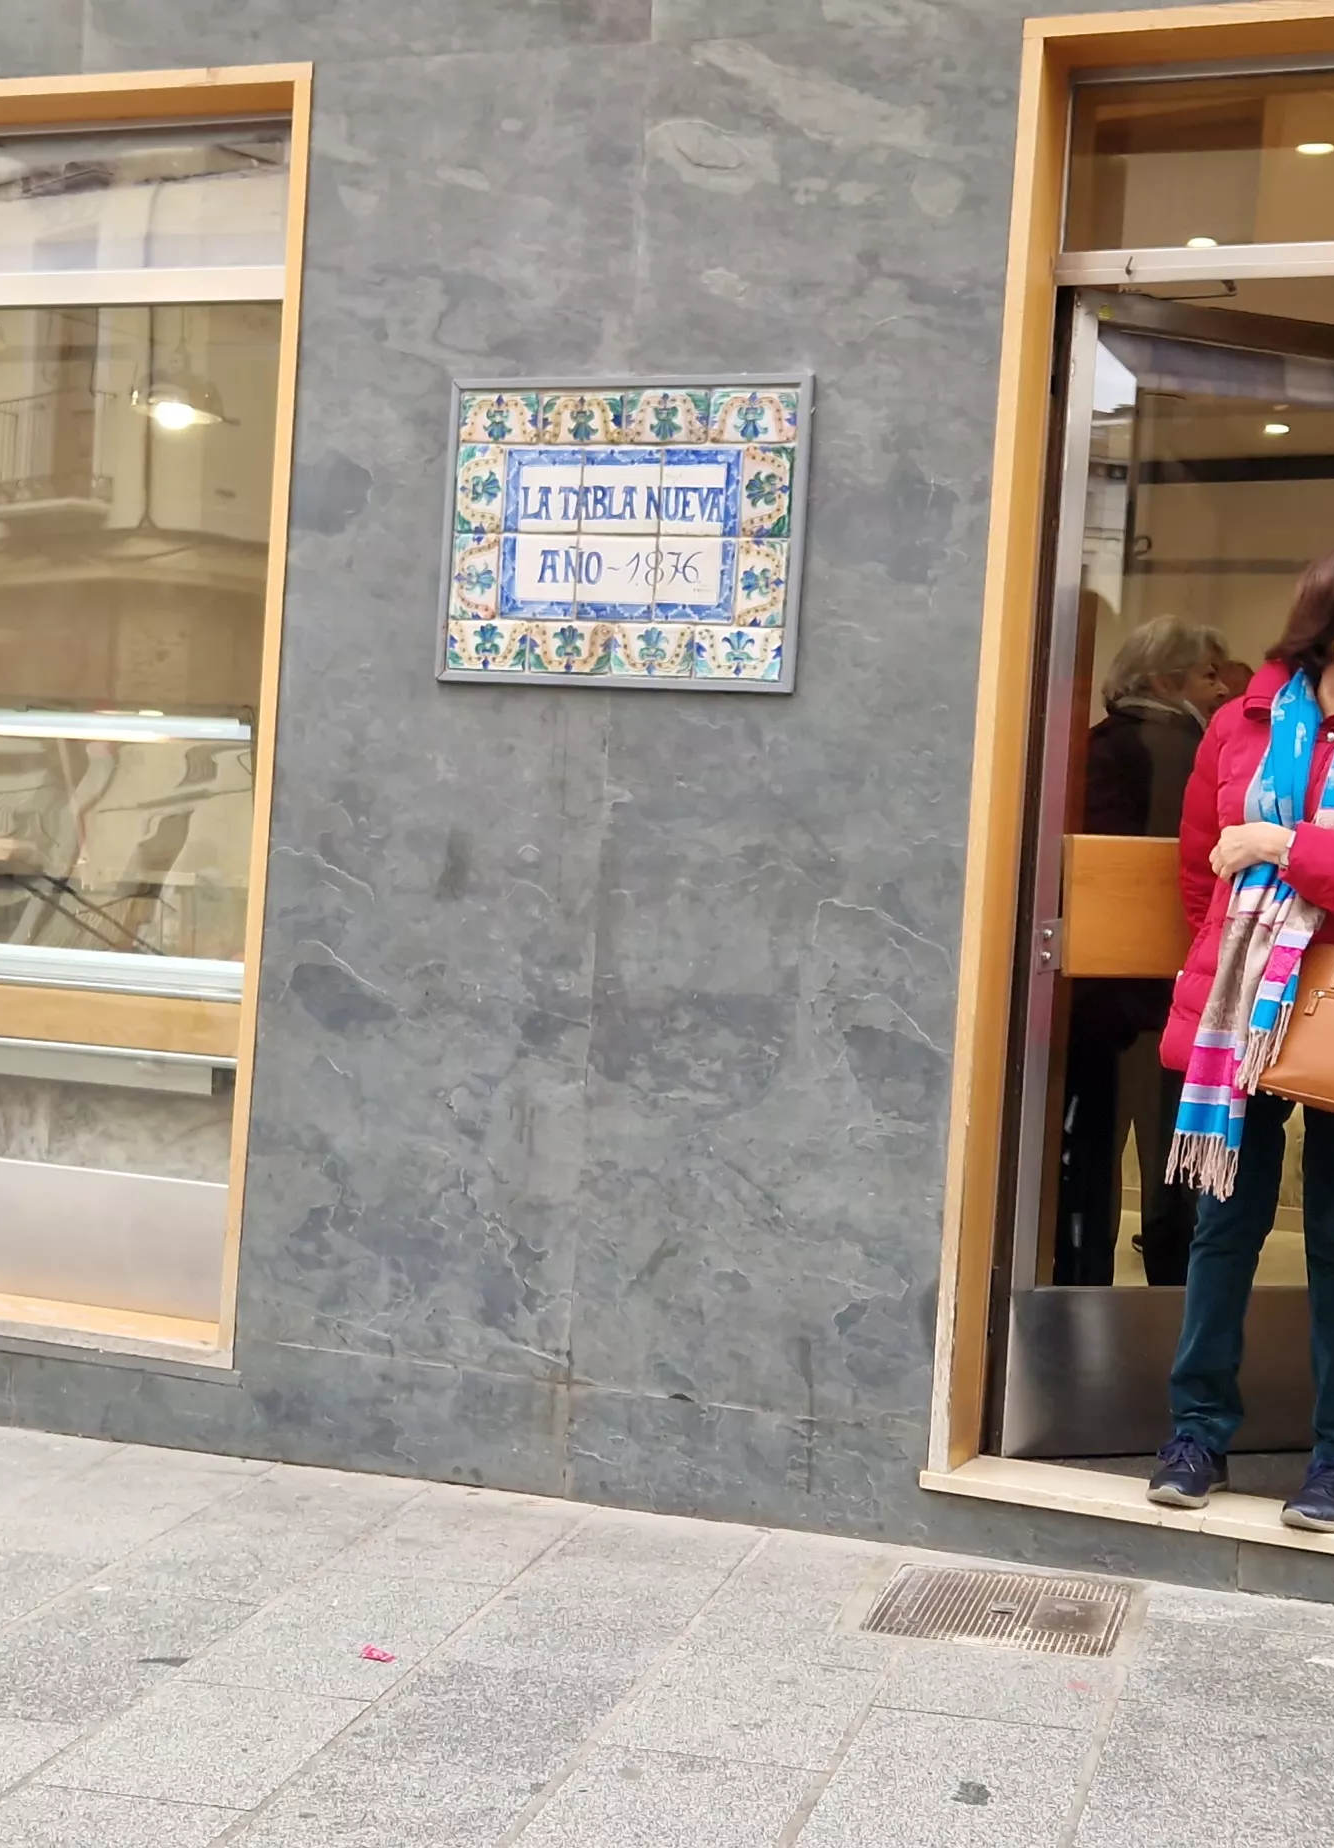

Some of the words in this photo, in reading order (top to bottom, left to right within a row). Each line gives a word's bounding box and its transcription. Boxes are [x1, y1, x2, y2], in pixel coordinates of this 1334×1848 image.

[521, 486, 552, 520] LA
[558, 485, 637, 521] TABLA
[645, 486, 724, 523] NUEVA
[537, 545, 603, 585] AÑO
